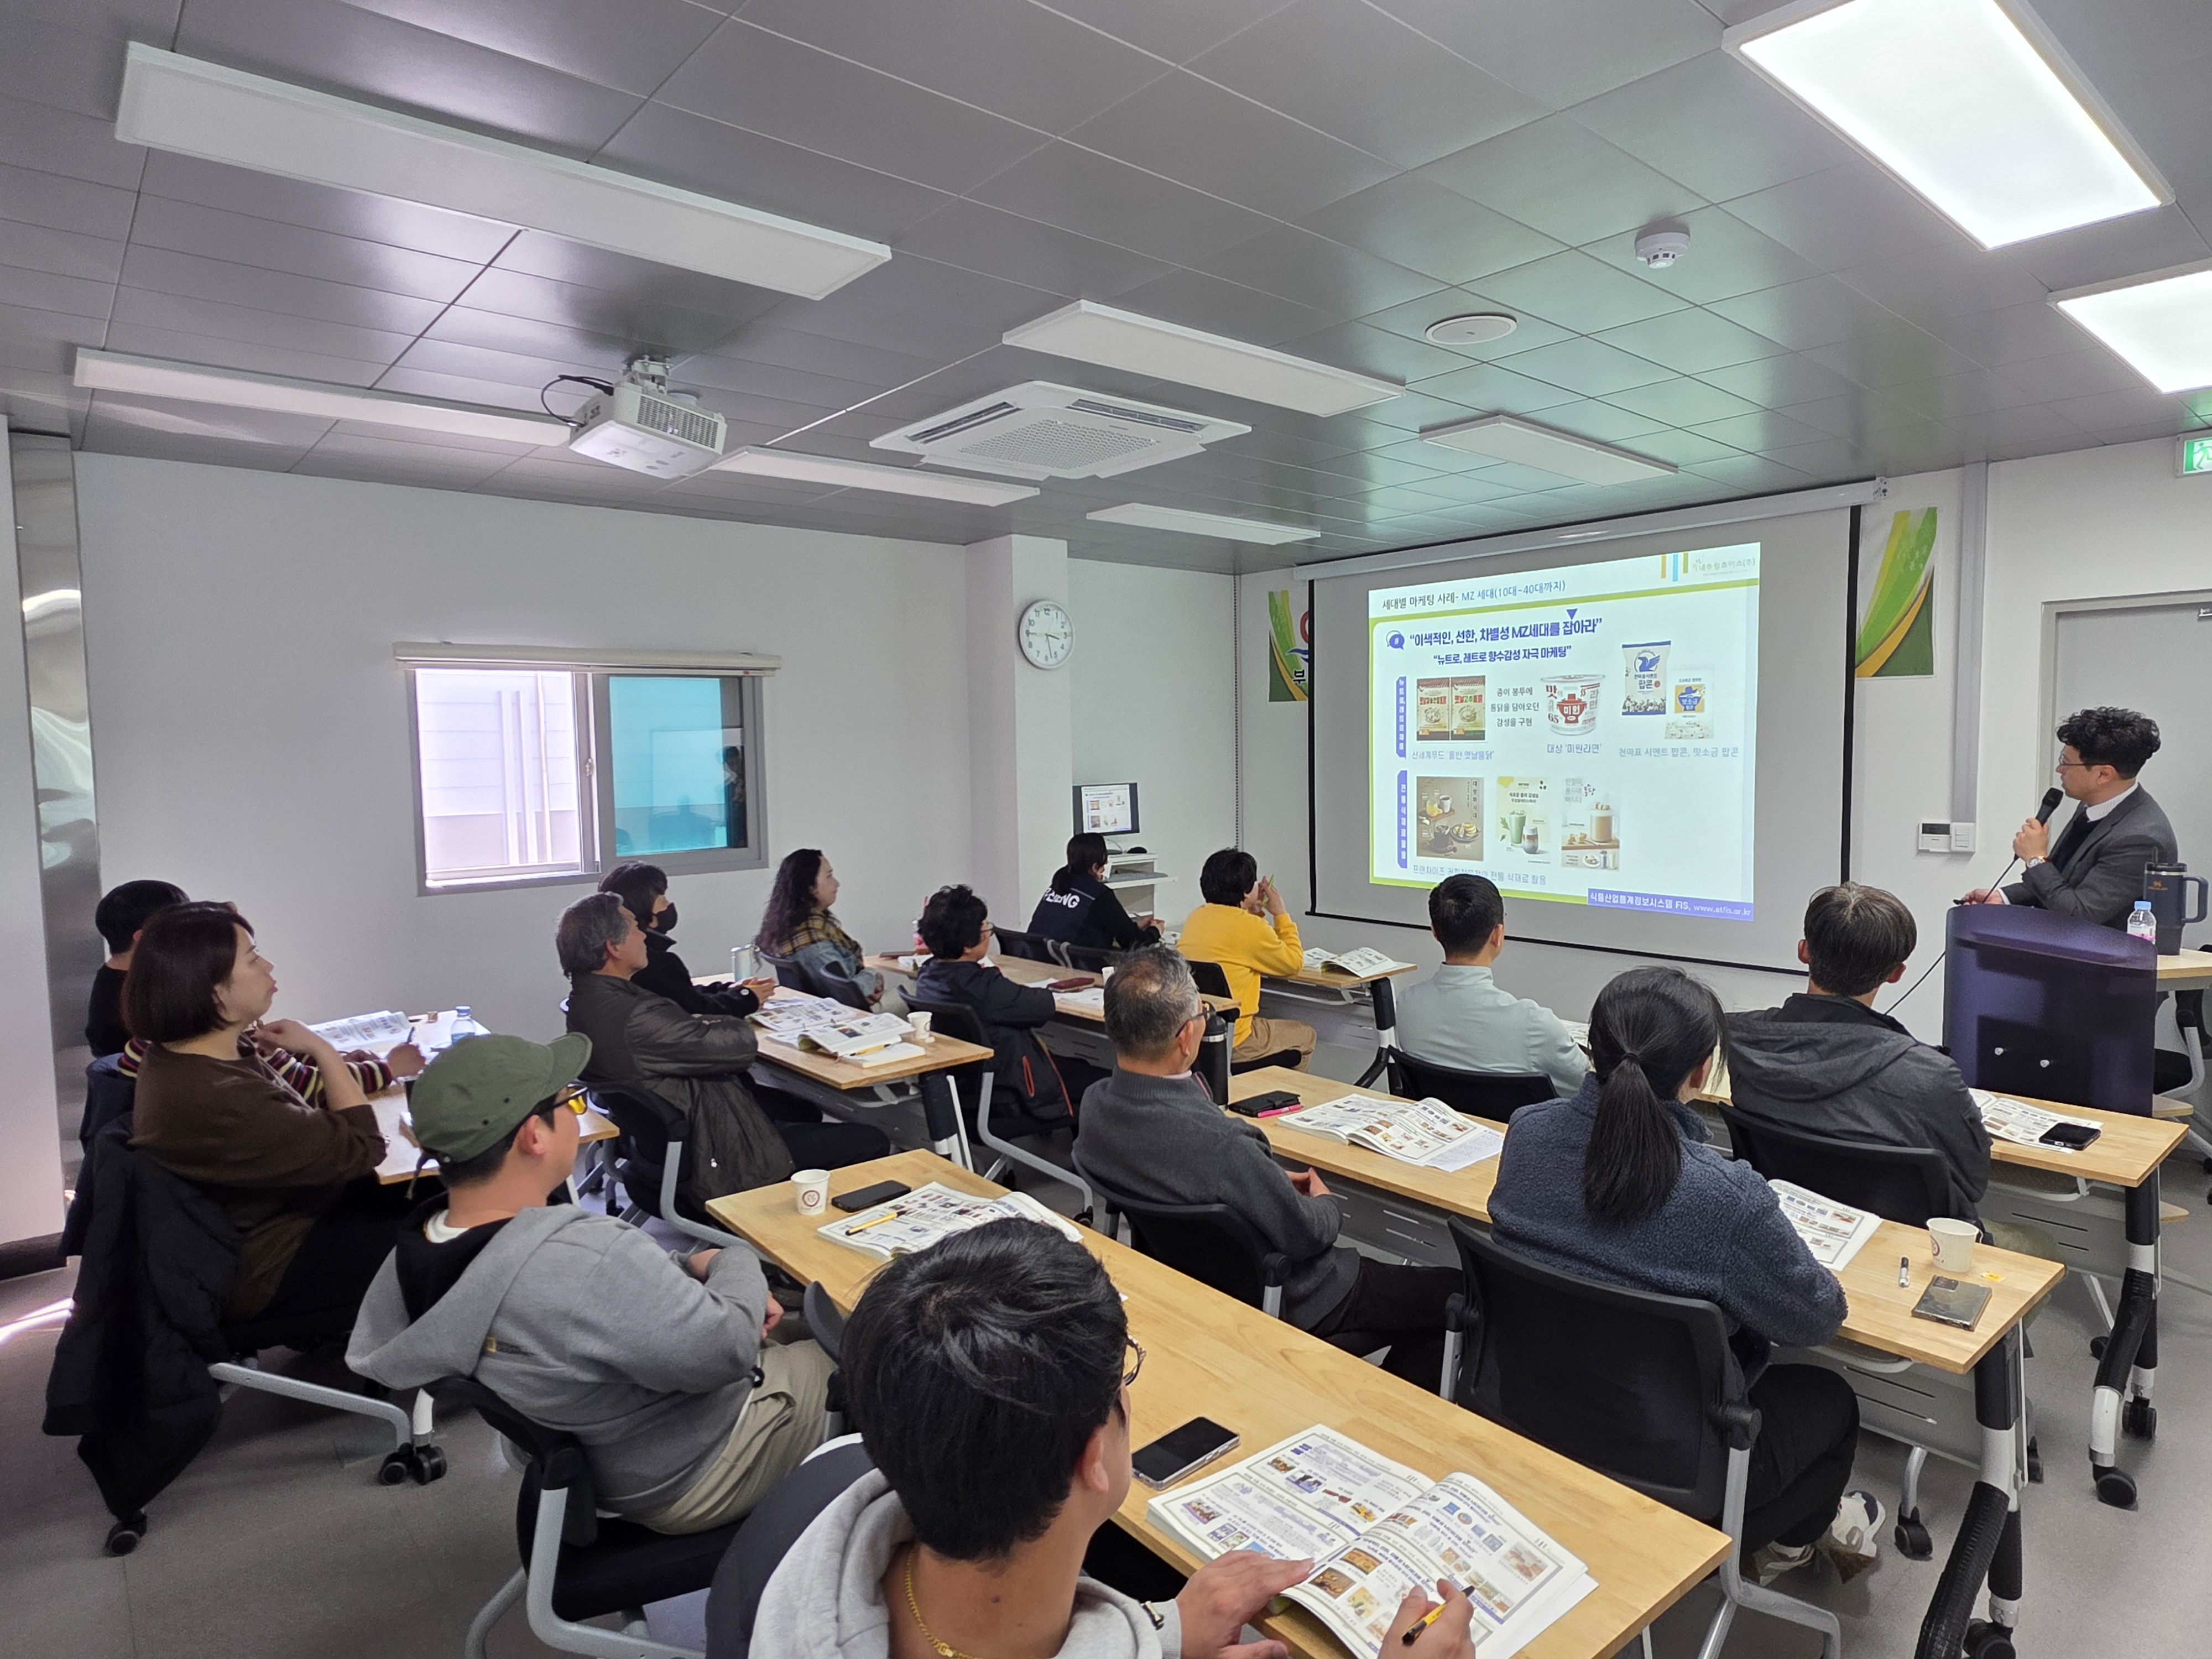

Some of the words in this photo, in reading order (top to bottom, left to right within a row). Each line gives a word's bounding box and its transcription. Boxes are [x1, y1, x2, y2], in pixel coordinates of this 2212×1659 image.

[1383, 597, 1406, 610] 세대별
[1410, 594, 1434, 607] 마케팅
[1462, 591, 1475, 601] MZ
[1477, 580, 1566, 600] 세대(10대~40대까지)
[1035, 609, 1040, 618] 11
[1455, 629, 1478, 644] 선한,
[1480, 626, 1509, 641] 차별성
[1512, 622, 1560, 639] MZ세대를
[1563, 618, 1602, 635] 잡아라”
[1463, 653, 1487, 664] 레트로
[1522, 648, 1539, 659] 자극
[1541, 645, 1572, 658] 마케팅”
[1639, 680, 1653, 690] 팝콘
[1497, 688, 1510, 697] 종이
[1512, 687, 1533, 696] 봉투에
[1490, 703, 1510, 712] 통닭을
[1512, 702, 1539, 712] 담아오던
[1563, 705, 1580, 715] 미원
[1497, 718, 1516, 727] 감성을
[1518, 718, 1532, 727] 구현
[1547, 744, 1562, 754] 대상
[1619, 747, 1642, 757] 천마표
[1693, 748, 1718, 758] 맛소금
[1721, 747, 1739, 758] 팝콘
[1412, 751, 1444, 760] 신세계푸드
[1413, 865, 1444, 875] 프랜차이즈
[1491, 871, 1504, 881] 전통
[1507, 873, 1529, 884] 식재료
[1531, 874, 1546, 885] 활용
